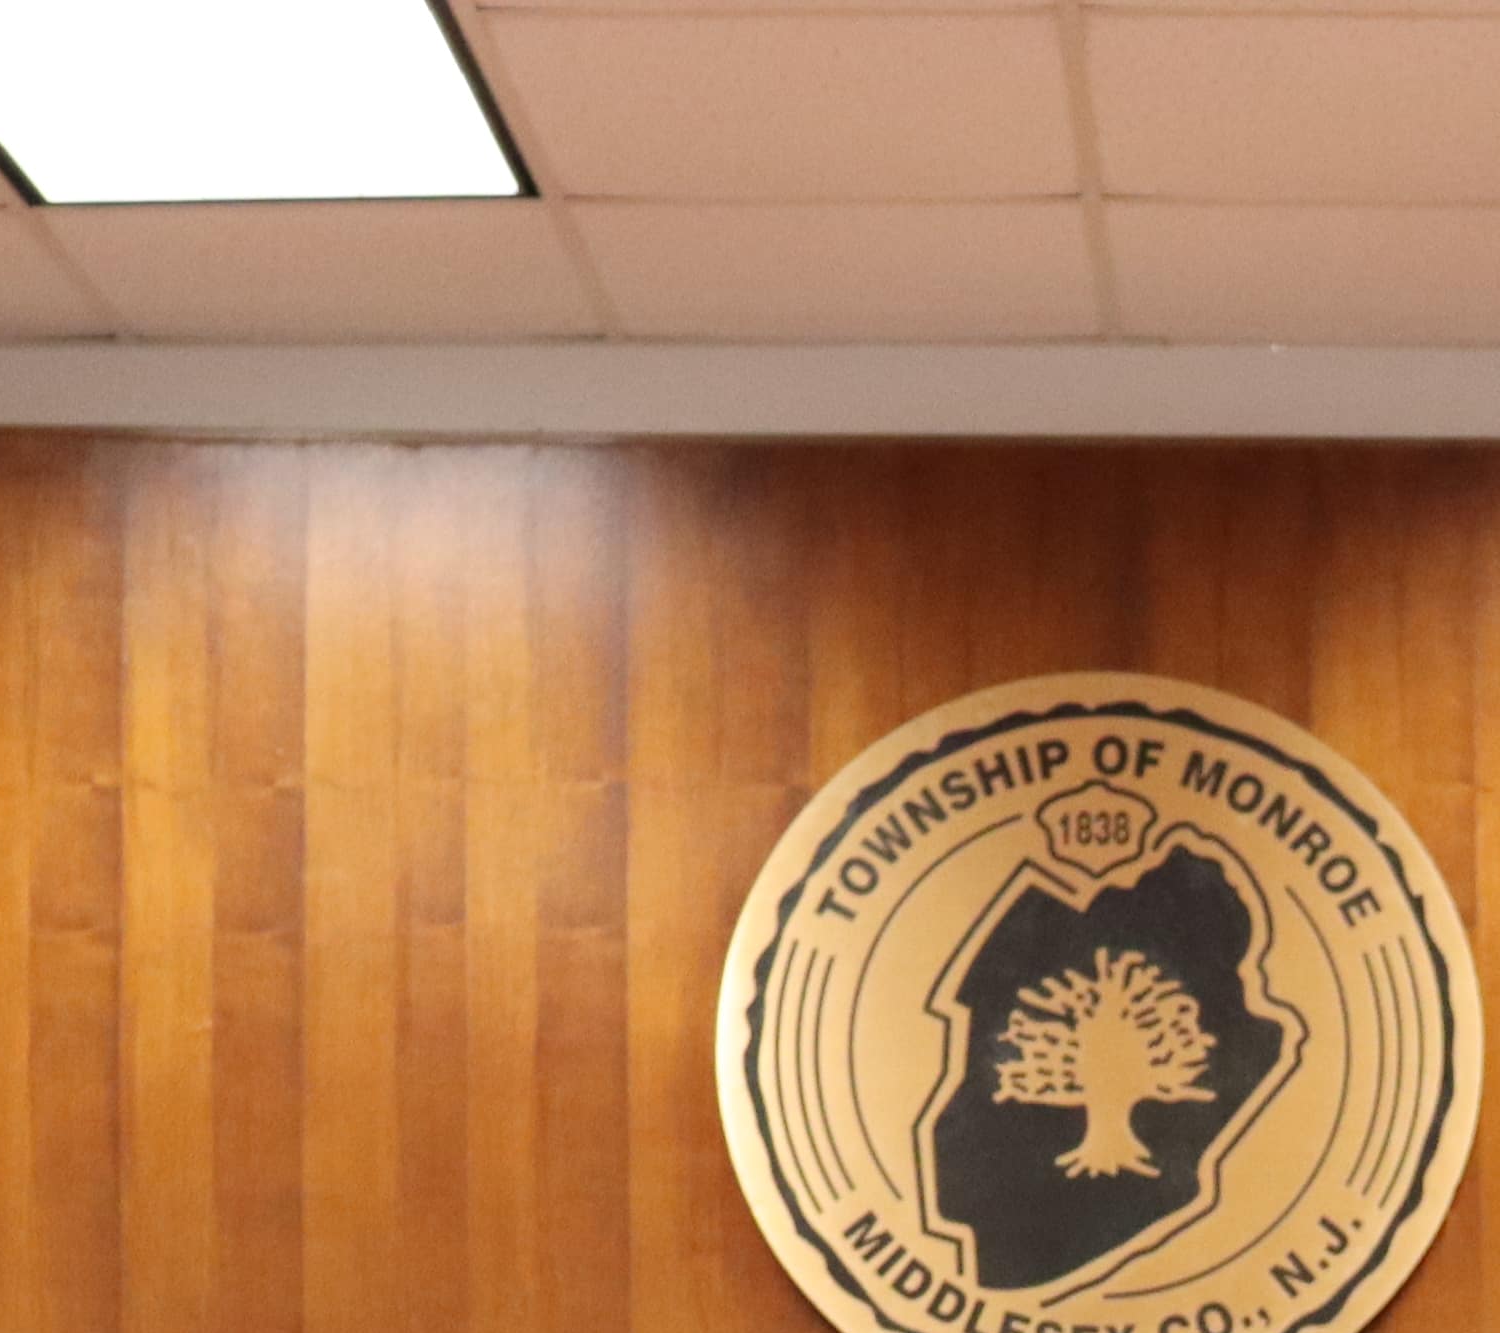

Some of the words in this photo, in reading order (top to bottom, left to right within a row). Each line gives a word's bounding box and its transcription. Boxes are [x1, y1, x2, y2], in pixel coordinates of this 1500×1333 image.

[816, 738, 1070, 925] TOWNSHIP
[1093, 735, 1167, 778] OF
[1181, 750, 1382, 928] MONROE
[1058, 810, 1132, 846] 1838
[1270, 1214, 1363, 1299] N.J.
